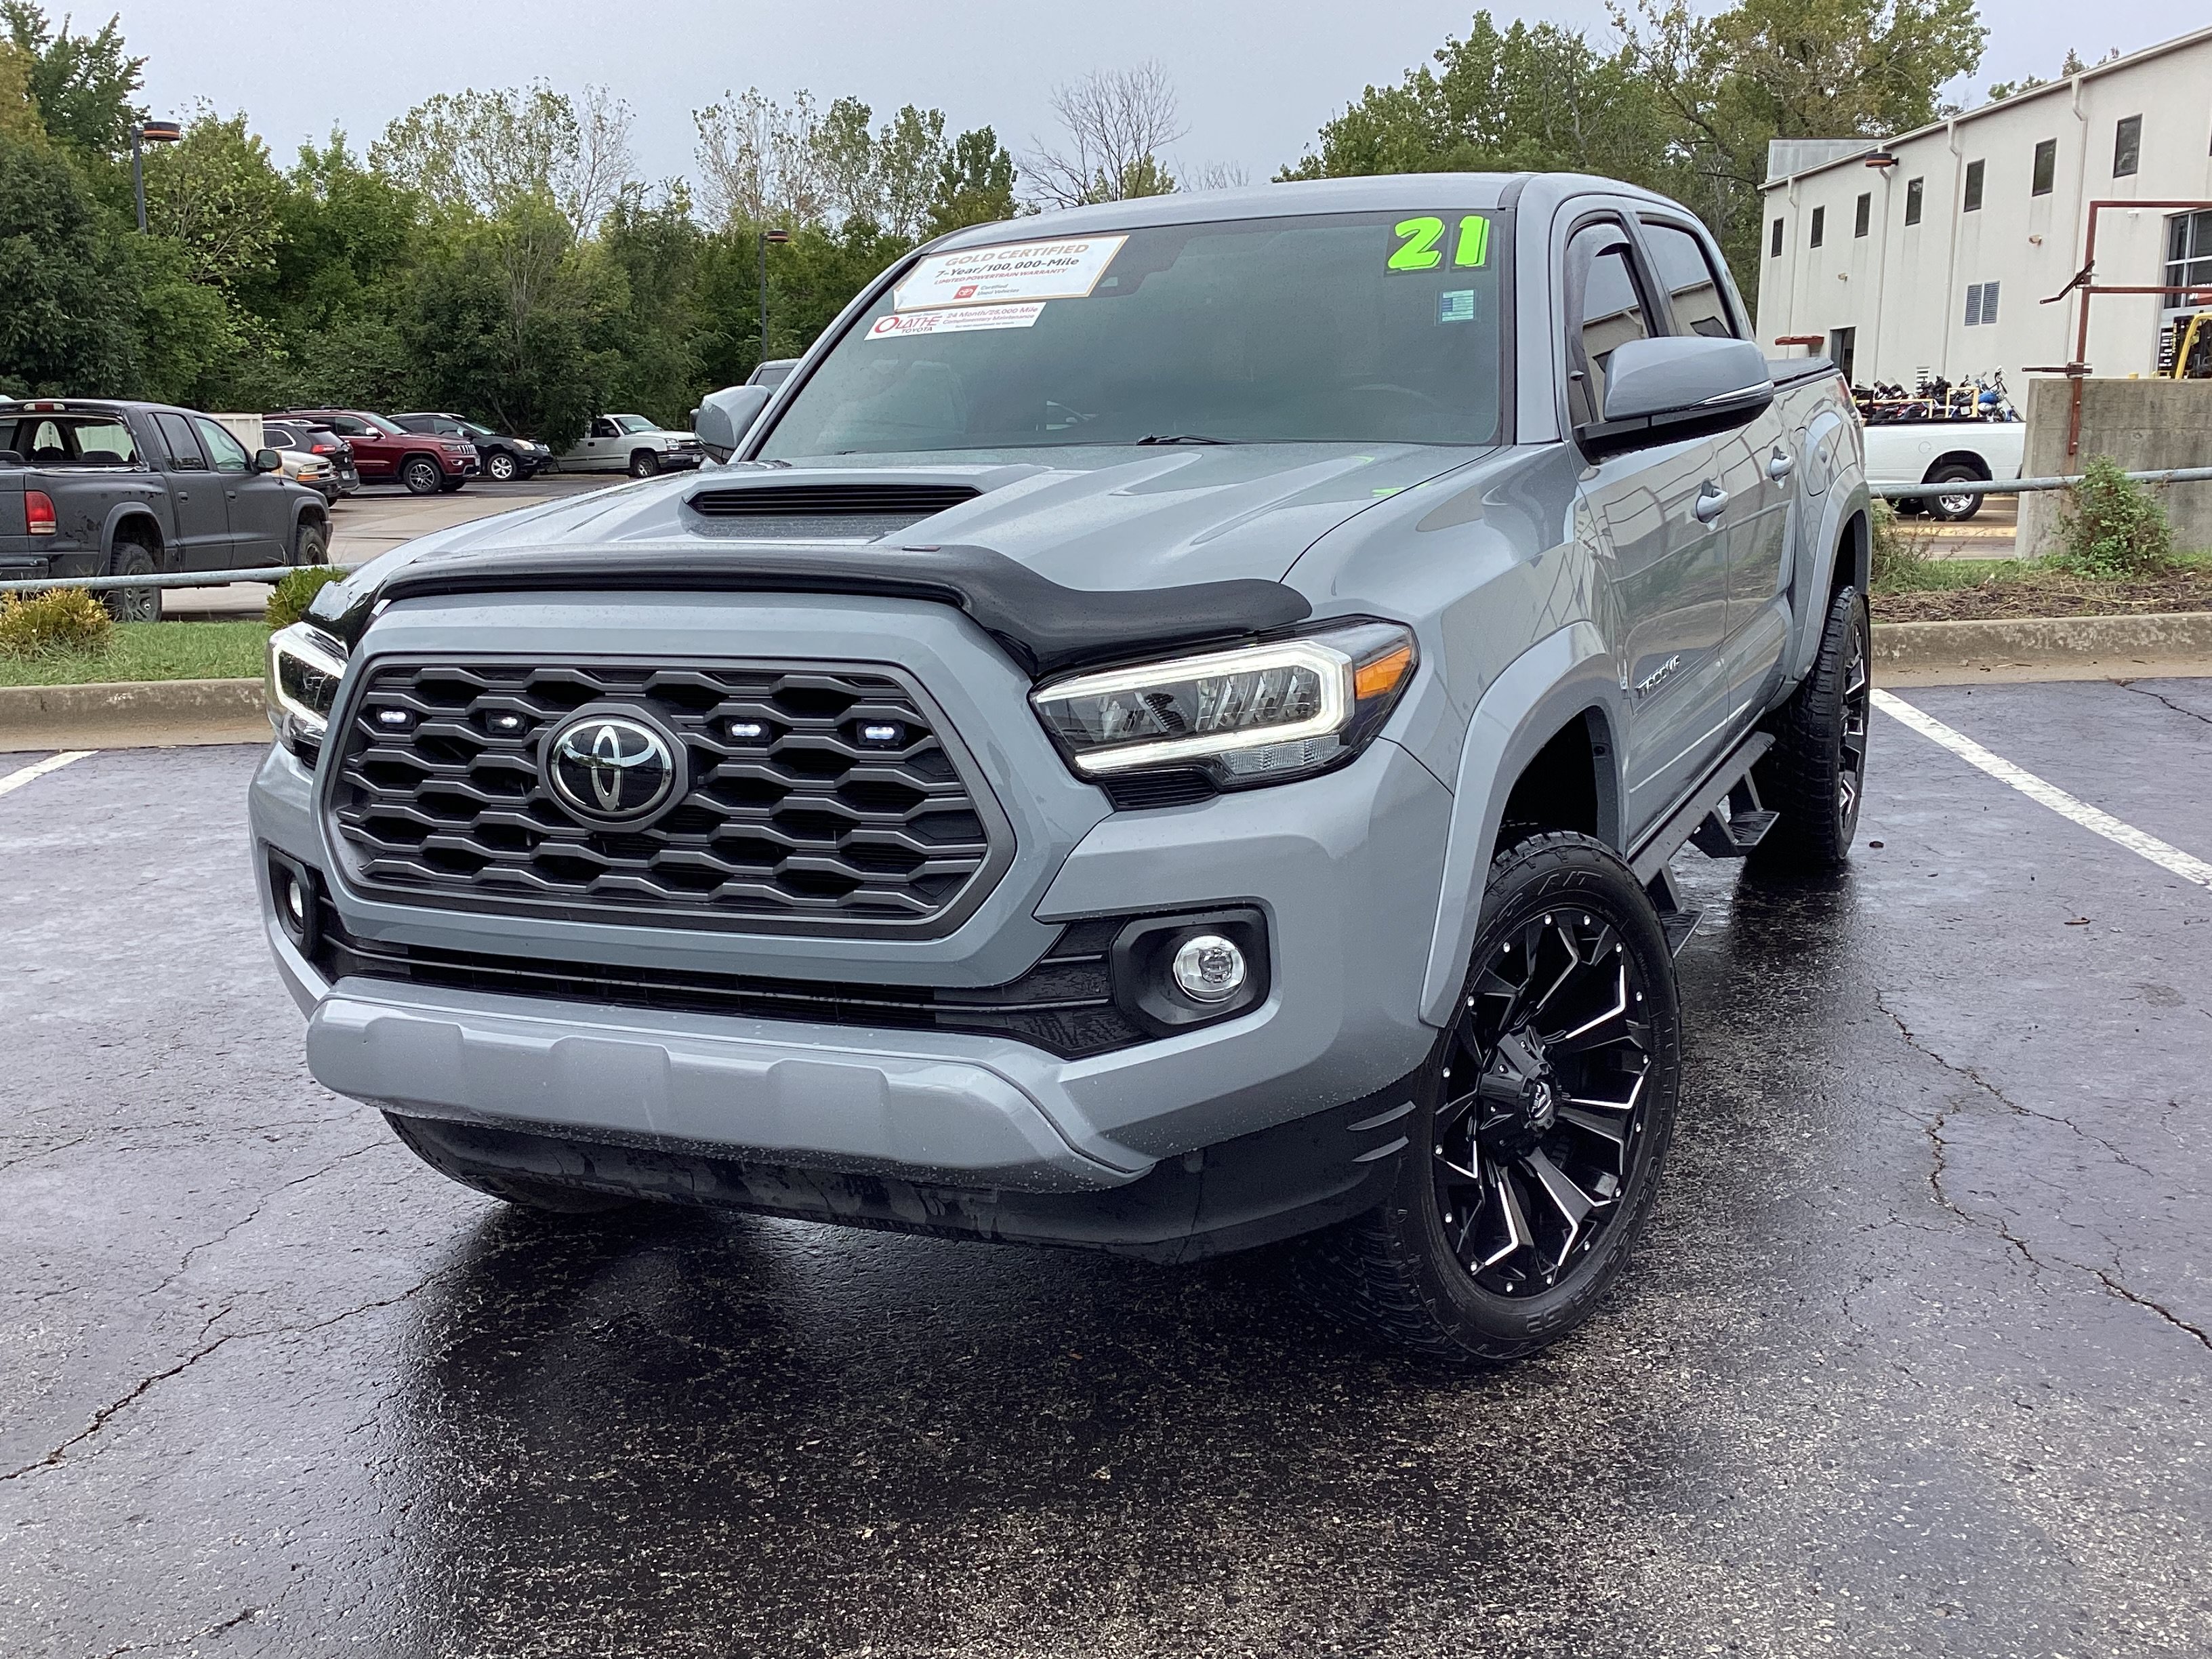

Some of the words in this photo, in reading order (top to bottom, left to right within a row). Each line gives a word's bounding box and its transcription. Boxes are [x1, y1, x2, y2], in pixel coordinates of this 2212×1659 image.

[1388, 214, 1490, 270] 21
[945, 253, 995, 266] GOLD
[998, 244, 1089, 260] CERTIFIED
[933, 276, 966, 285] LIMITED
[966, 271, 1019, 282] POWERTRAIN
[1020, 268, 1068, 276] WARRANTY
[874, 315, 943, 333] OLATHE
[901, 326, 933, 334] TOYOTA
